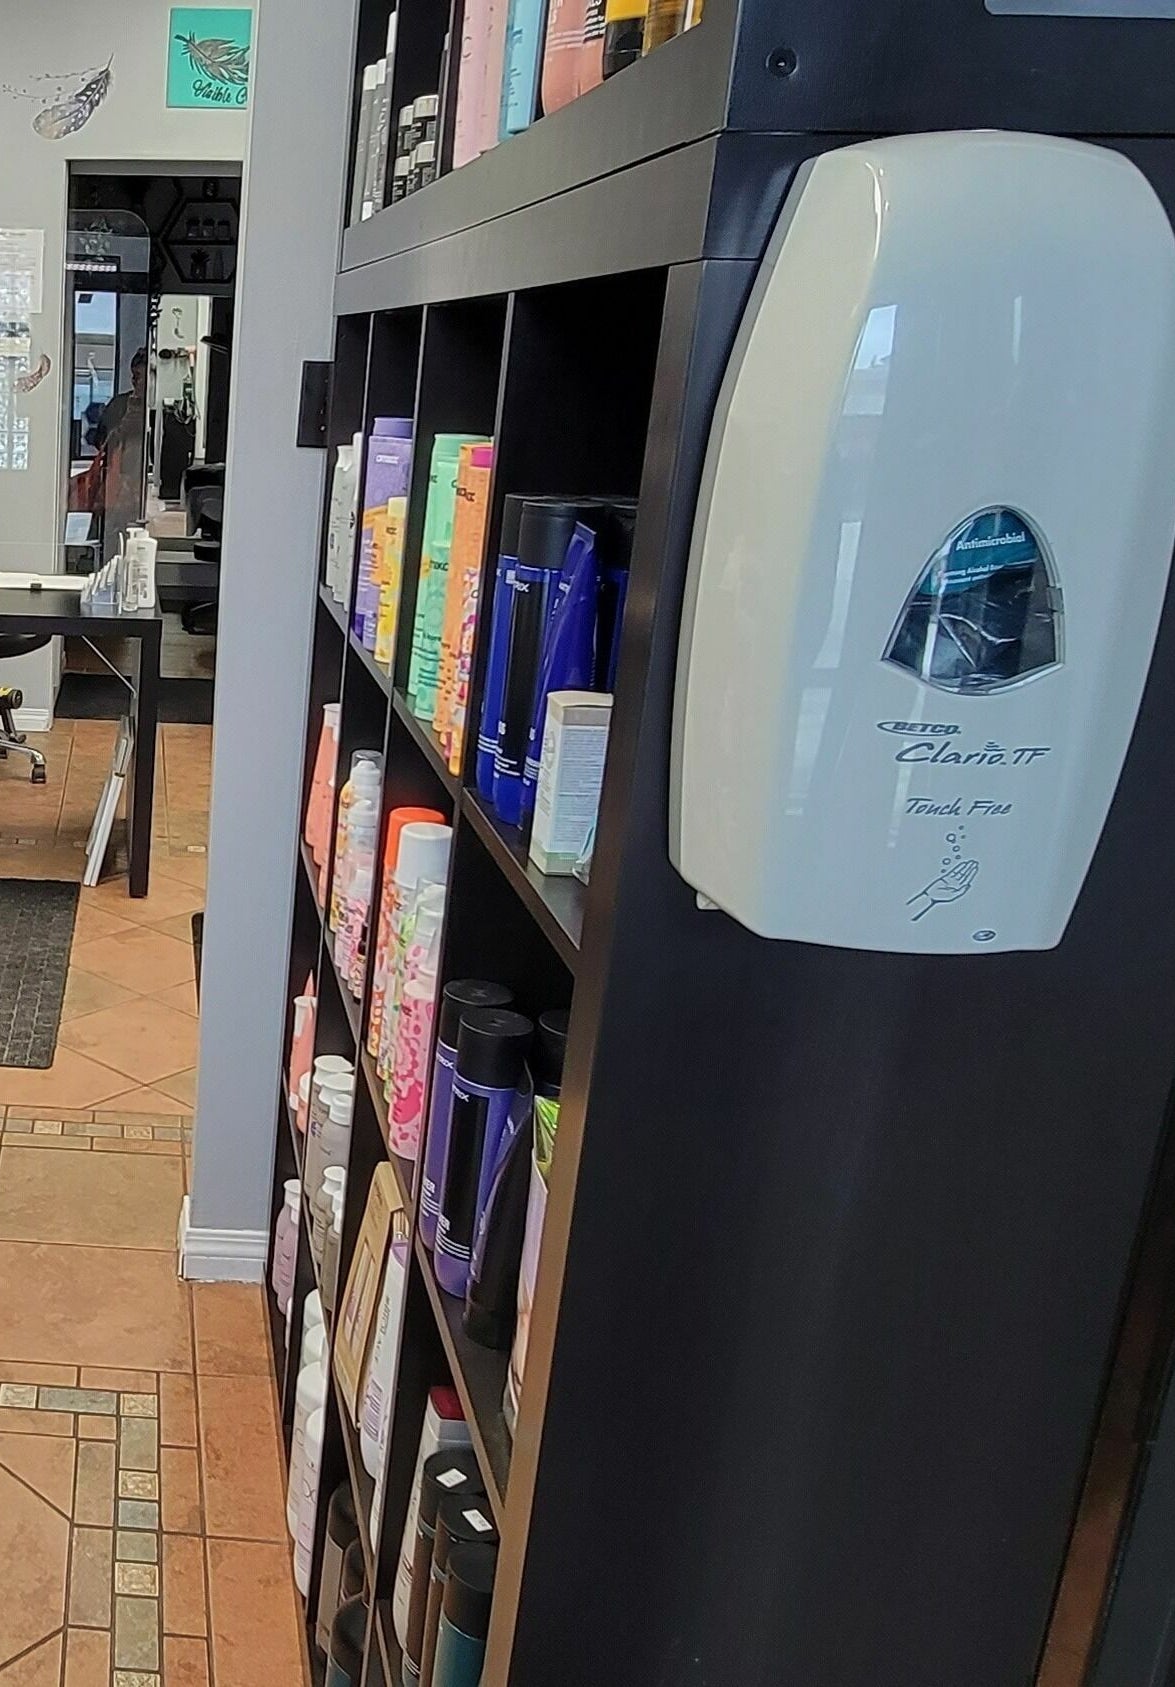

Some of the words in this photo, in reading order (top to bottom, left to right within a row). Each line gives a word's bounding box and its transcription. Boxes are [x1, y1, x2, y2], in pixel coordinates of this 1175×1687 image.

[955, 531, 1026, 551] Antimicrobial
[891, 721, 960, 735] BETCO
[895, 741, 1002, 765] Clario
[1012, 747, 1052, 765] TF
[905, 797, 963, 816] Touch
[966, 800, 1013, 816] Free
